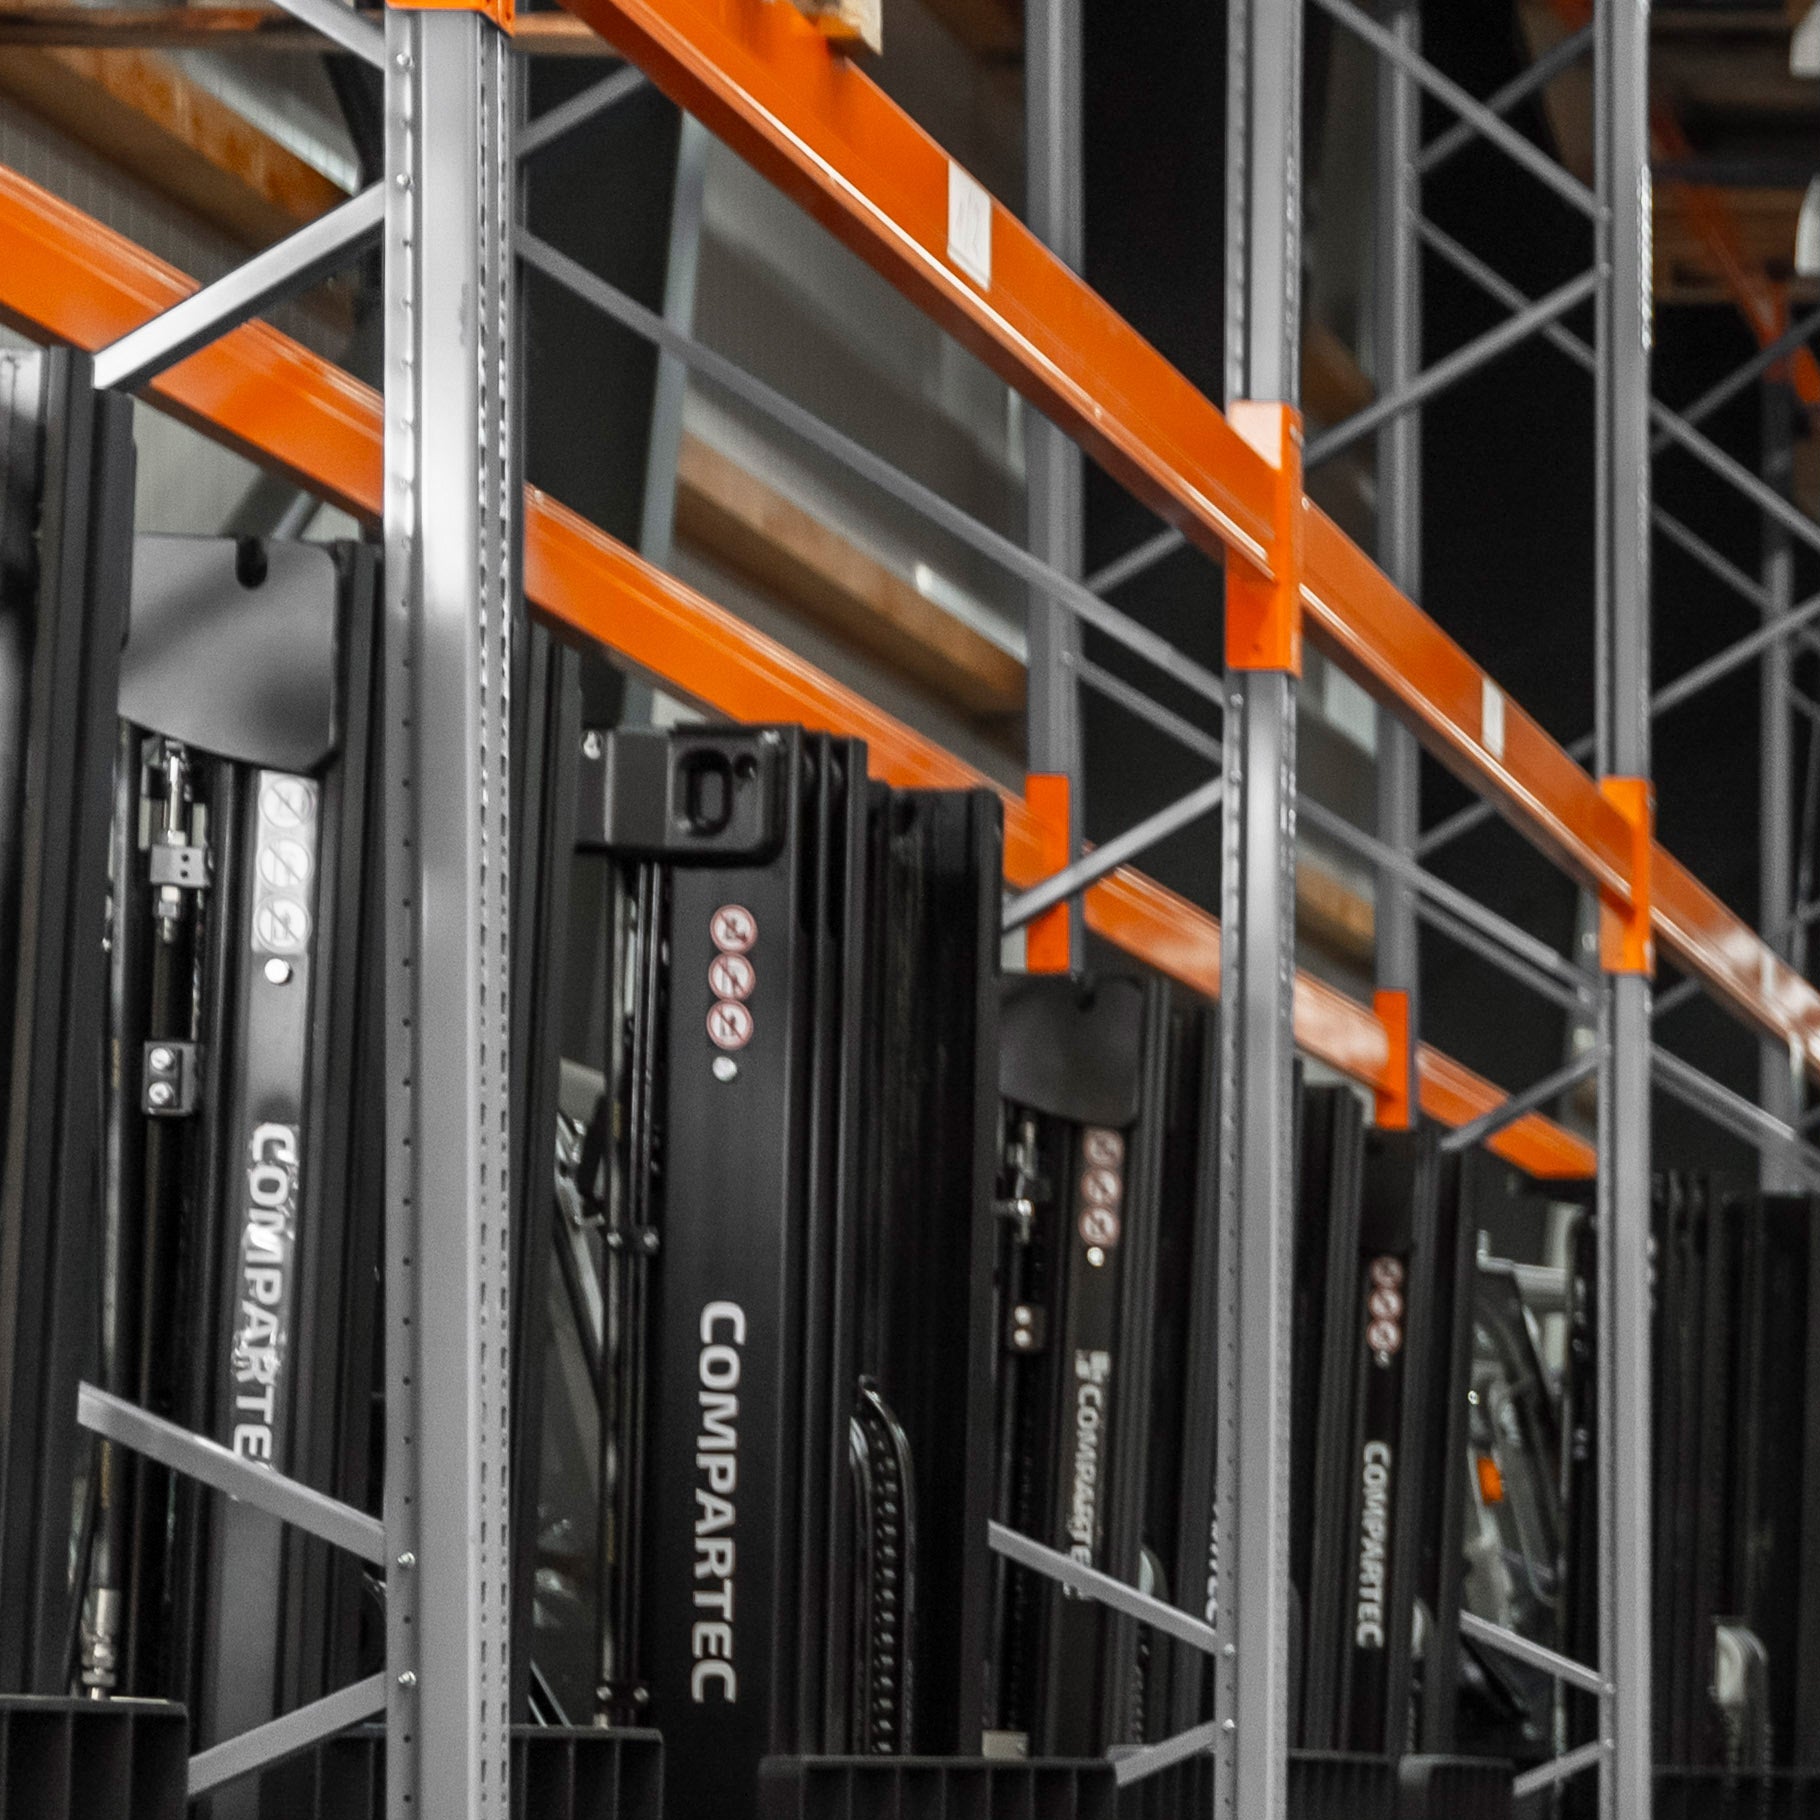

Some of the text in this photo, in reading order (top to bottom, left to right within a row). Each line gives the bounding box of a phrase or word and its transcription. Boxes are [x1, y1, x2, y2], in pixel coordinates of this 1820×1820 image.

[229, 1121, 297, 1490] COMPARTE
[690, 1299, 746, 1704] COMPARTEC
[1356, 1440, 1391, 1648] COMPARTEC
